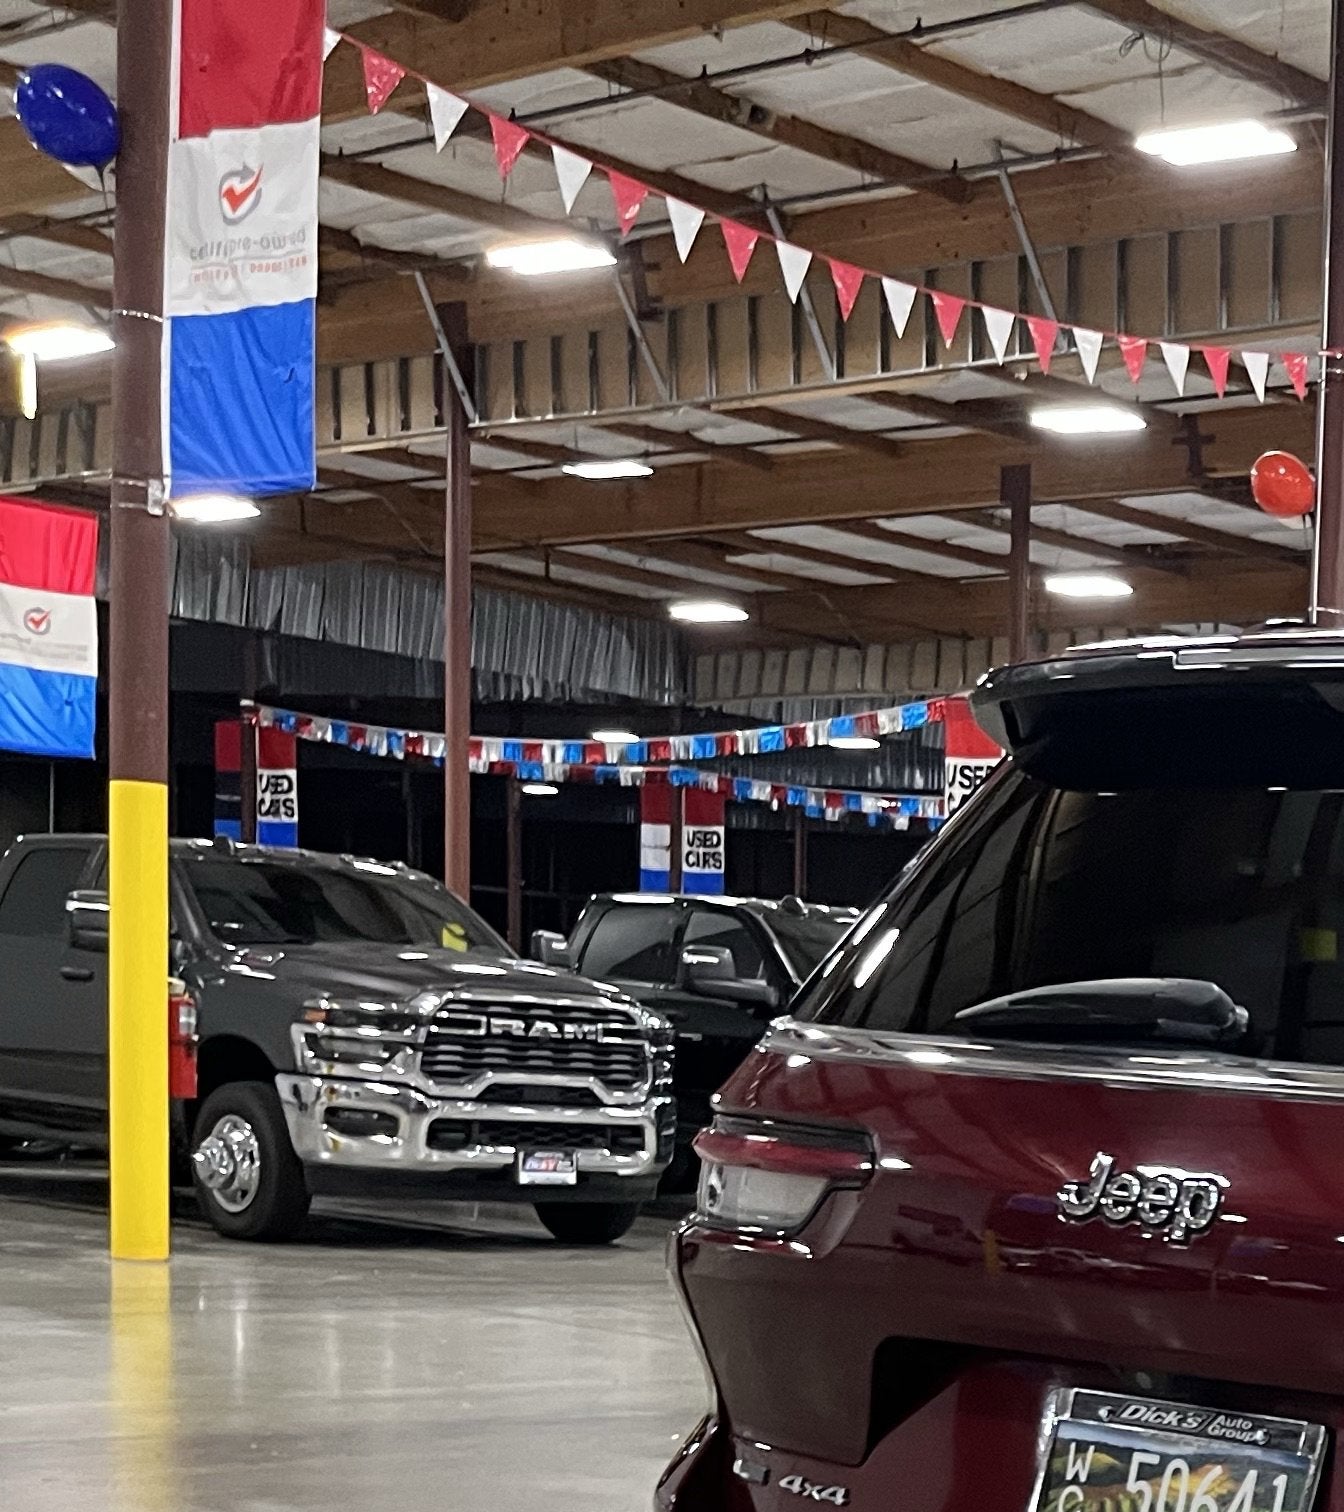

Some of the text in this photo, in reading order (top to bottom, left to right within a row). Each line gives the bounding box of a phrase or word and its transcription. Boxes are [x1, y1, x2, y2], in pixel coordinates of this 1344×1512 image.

[948, 765, 995, 789] USE
[490, 1017, 598, 1040] RAM
[1057, 1151, 1219, 1241] Jeep
[1119, 1404, 1253, 1430] Dick's Auto
[778, 1474, 846, 1506] 4x4
